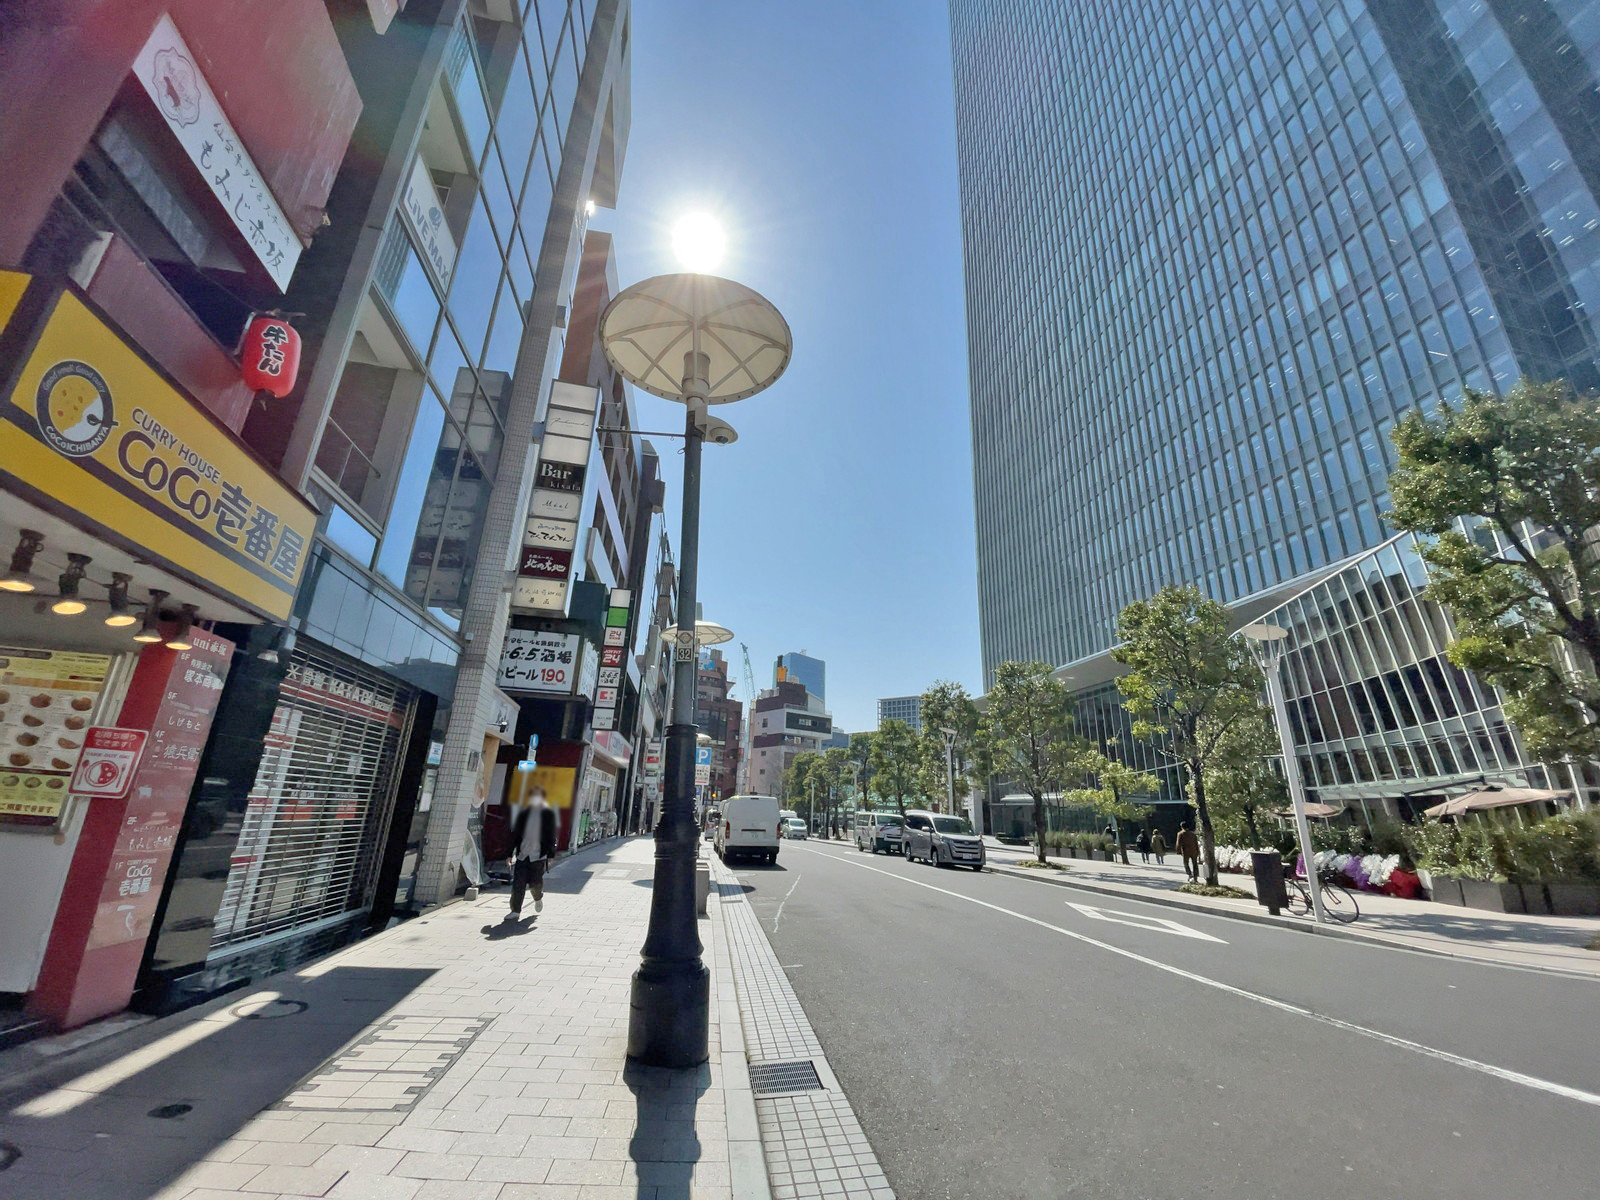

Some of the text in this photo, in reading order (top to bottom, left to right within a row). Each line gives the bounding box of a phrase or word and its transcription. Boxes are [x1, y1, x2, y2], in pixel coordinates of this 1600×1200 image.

[200, 140, 284, 277] もみじ赤坂
[428, 236, 449, 284] MAX
[258, 325, 288, 376] 牛たん
[43, 371, 58, 390] Good
[76, 366, 93, 378] Good
[132, 408, 221, 484] CURRY HOUSE
[541, 463, 572, 480] Bar
[524, 559, 566, 572] 北の大地
[602, 654, 621, 664] 24
[679, 649, 690, 660] 32
[541, 668, 565, 683] 190
[167, 691, 178, 699] 5F
[168, 715, 201, 731] しげもと
[95, 731, 137, 740] お持ち帰り
[155, 730, 165, 738] 4F
[698, 749, 709, 763] P
[114, 862, 125, 871] 1F
[126, 864, 153, 878] CoCo
[119, 877, 152, 896] 壱番屋
